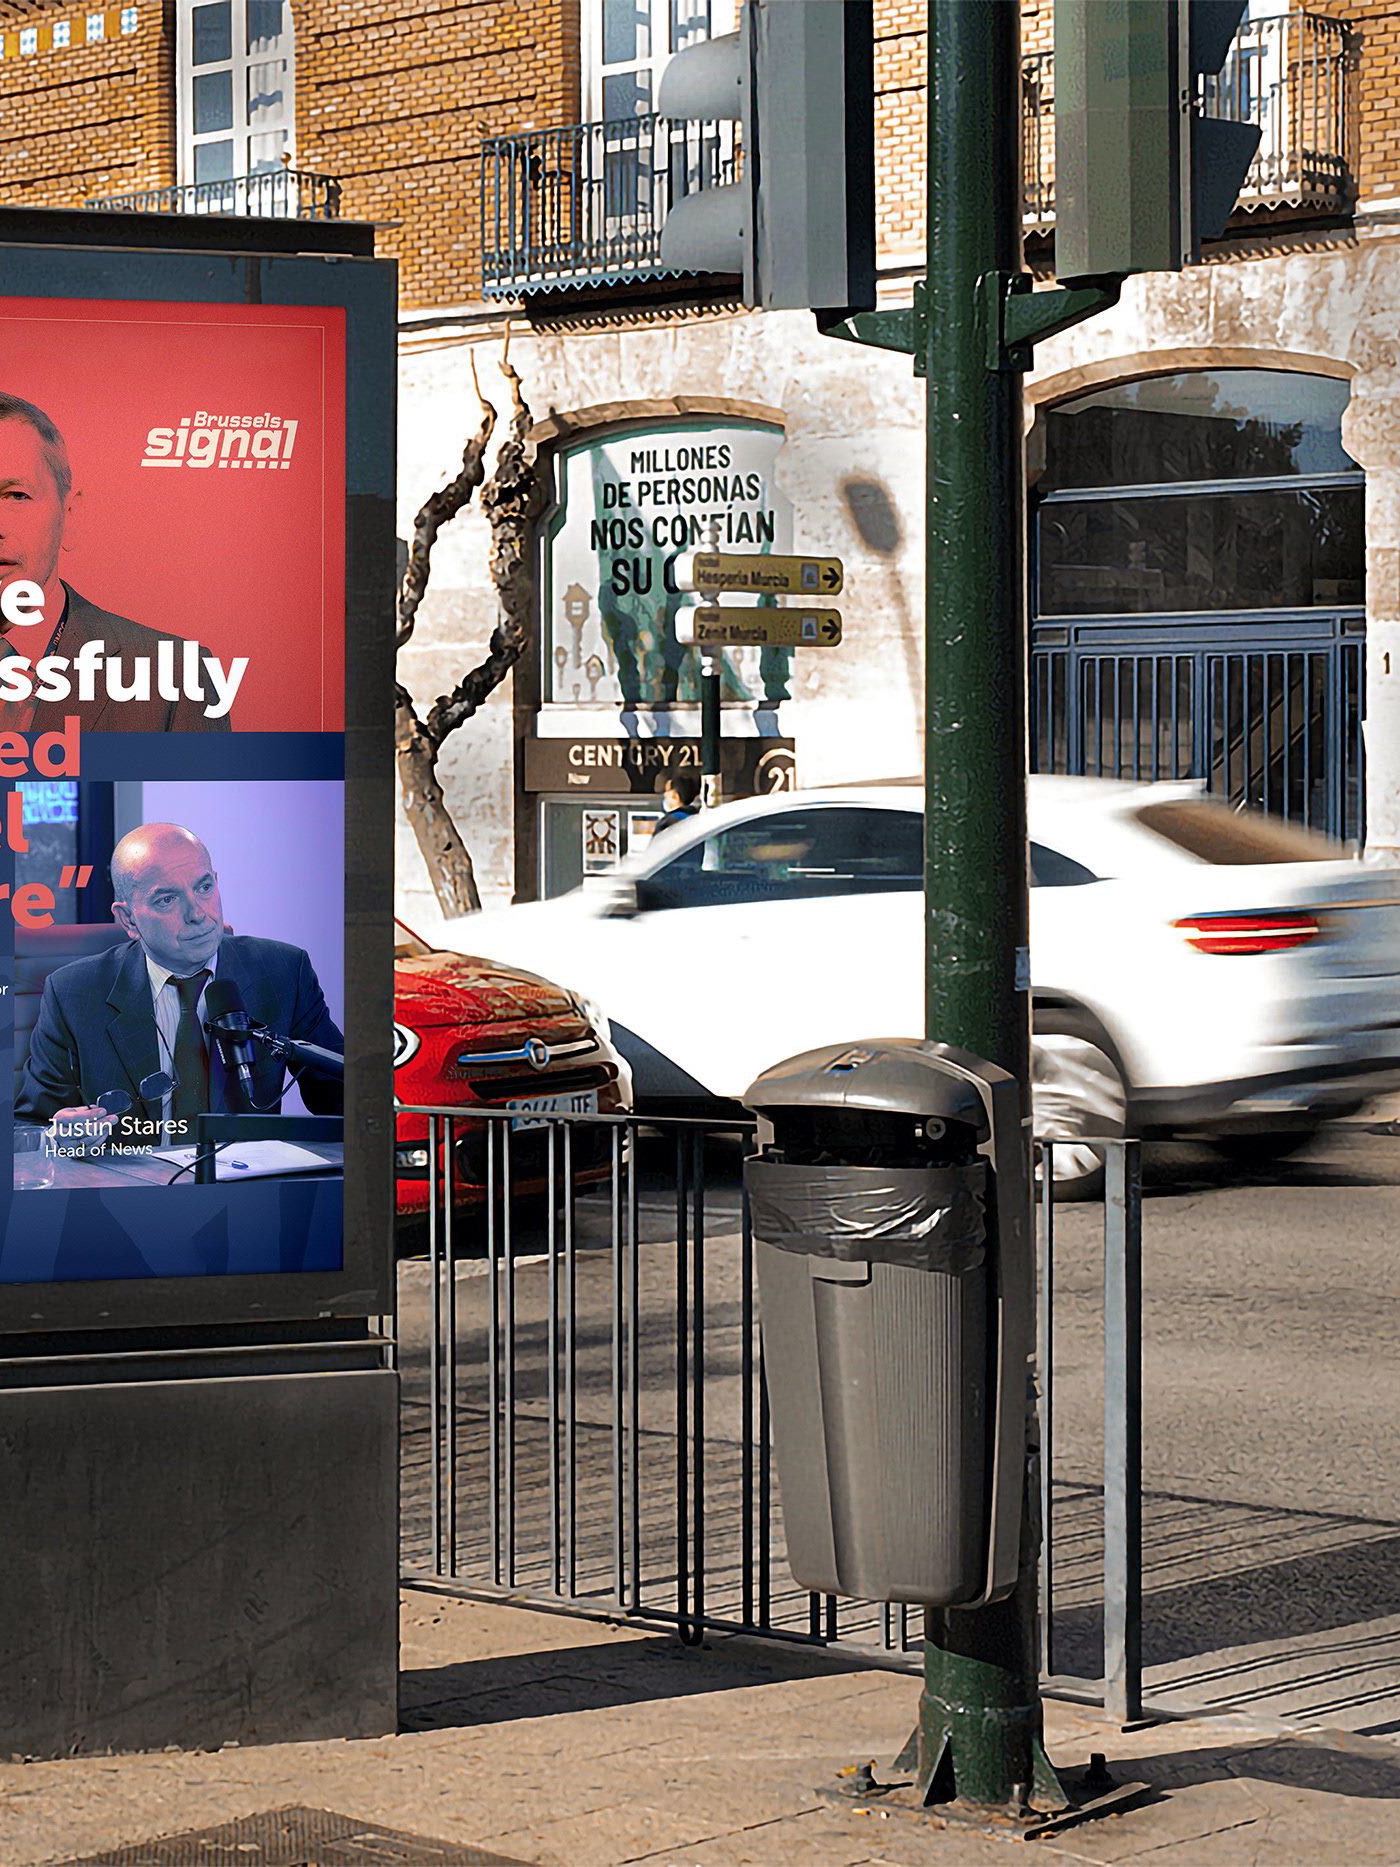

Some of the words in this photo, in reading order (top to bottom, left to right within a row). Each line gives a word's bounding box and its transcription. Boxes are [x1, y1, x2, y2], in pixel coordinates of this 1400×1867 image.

[194, 411, 281, 428] Brussels
[144, 417, 299, 468] signal
[630, 444, 731, 474] MILLONES
[603, 482, 631, 510] DE
[638, 473, 760, 507] PERSONAS
[591, 517, 644, 550] NOS
[611, 557, 652, 596] SU
[569, 745, 674, 767] CENTURY
[45, 1117, 113, 1138] Justin
[120, 1116, 189, 1136] Stares
[45, 1142, 85, 1158] Head
[89, 1142, 107, 1157] of
[111, 1142, 153, 1156] News
